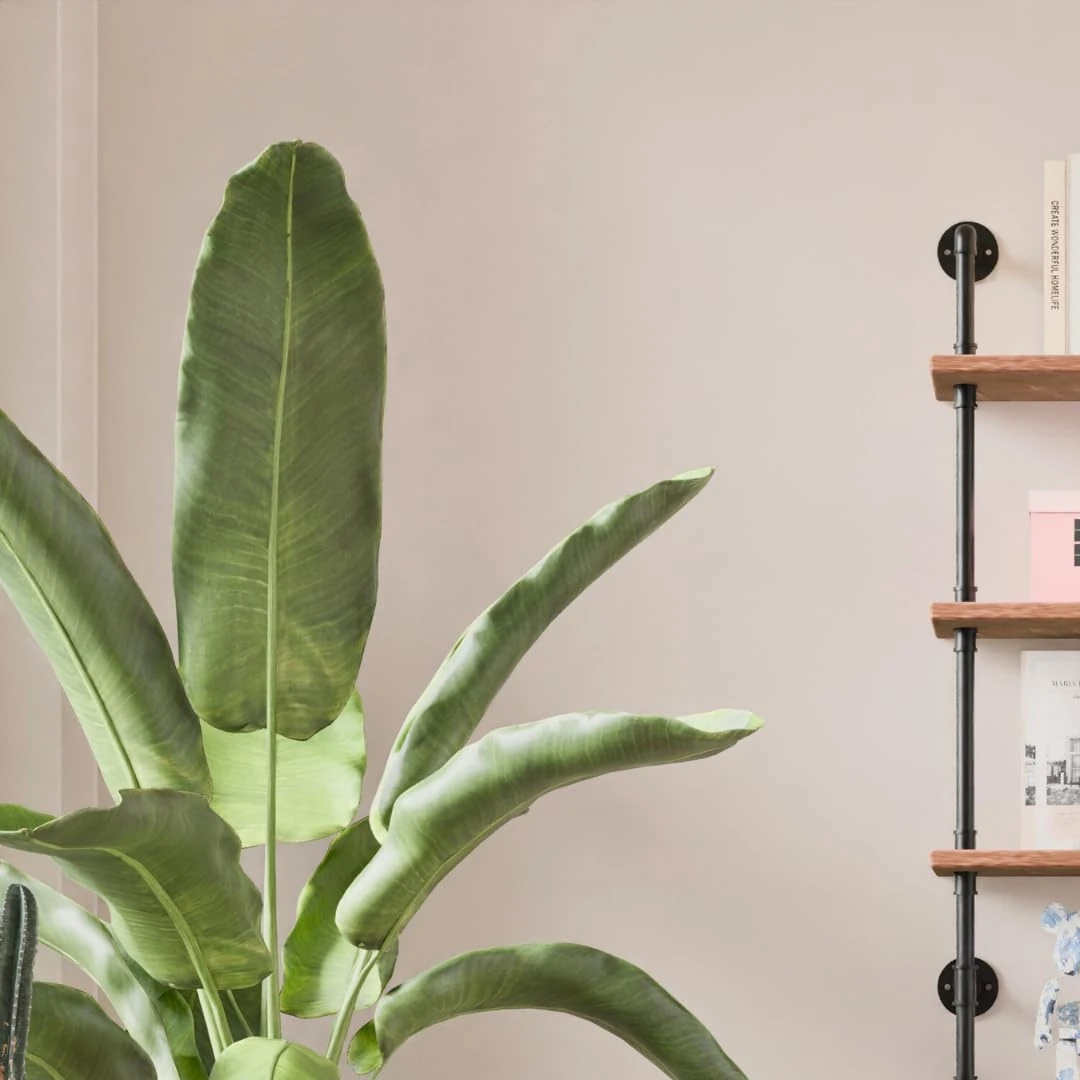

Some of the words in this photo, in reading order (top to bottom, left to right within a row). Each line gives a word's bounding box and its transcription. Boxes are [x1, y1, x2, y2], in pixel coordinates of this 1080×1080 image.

[1050, 200, 1060, 227] CREATE
[1050, 229, 1060, 273] WONDERFUL
[1050, 274, 1060, 310] HOMELIFE
